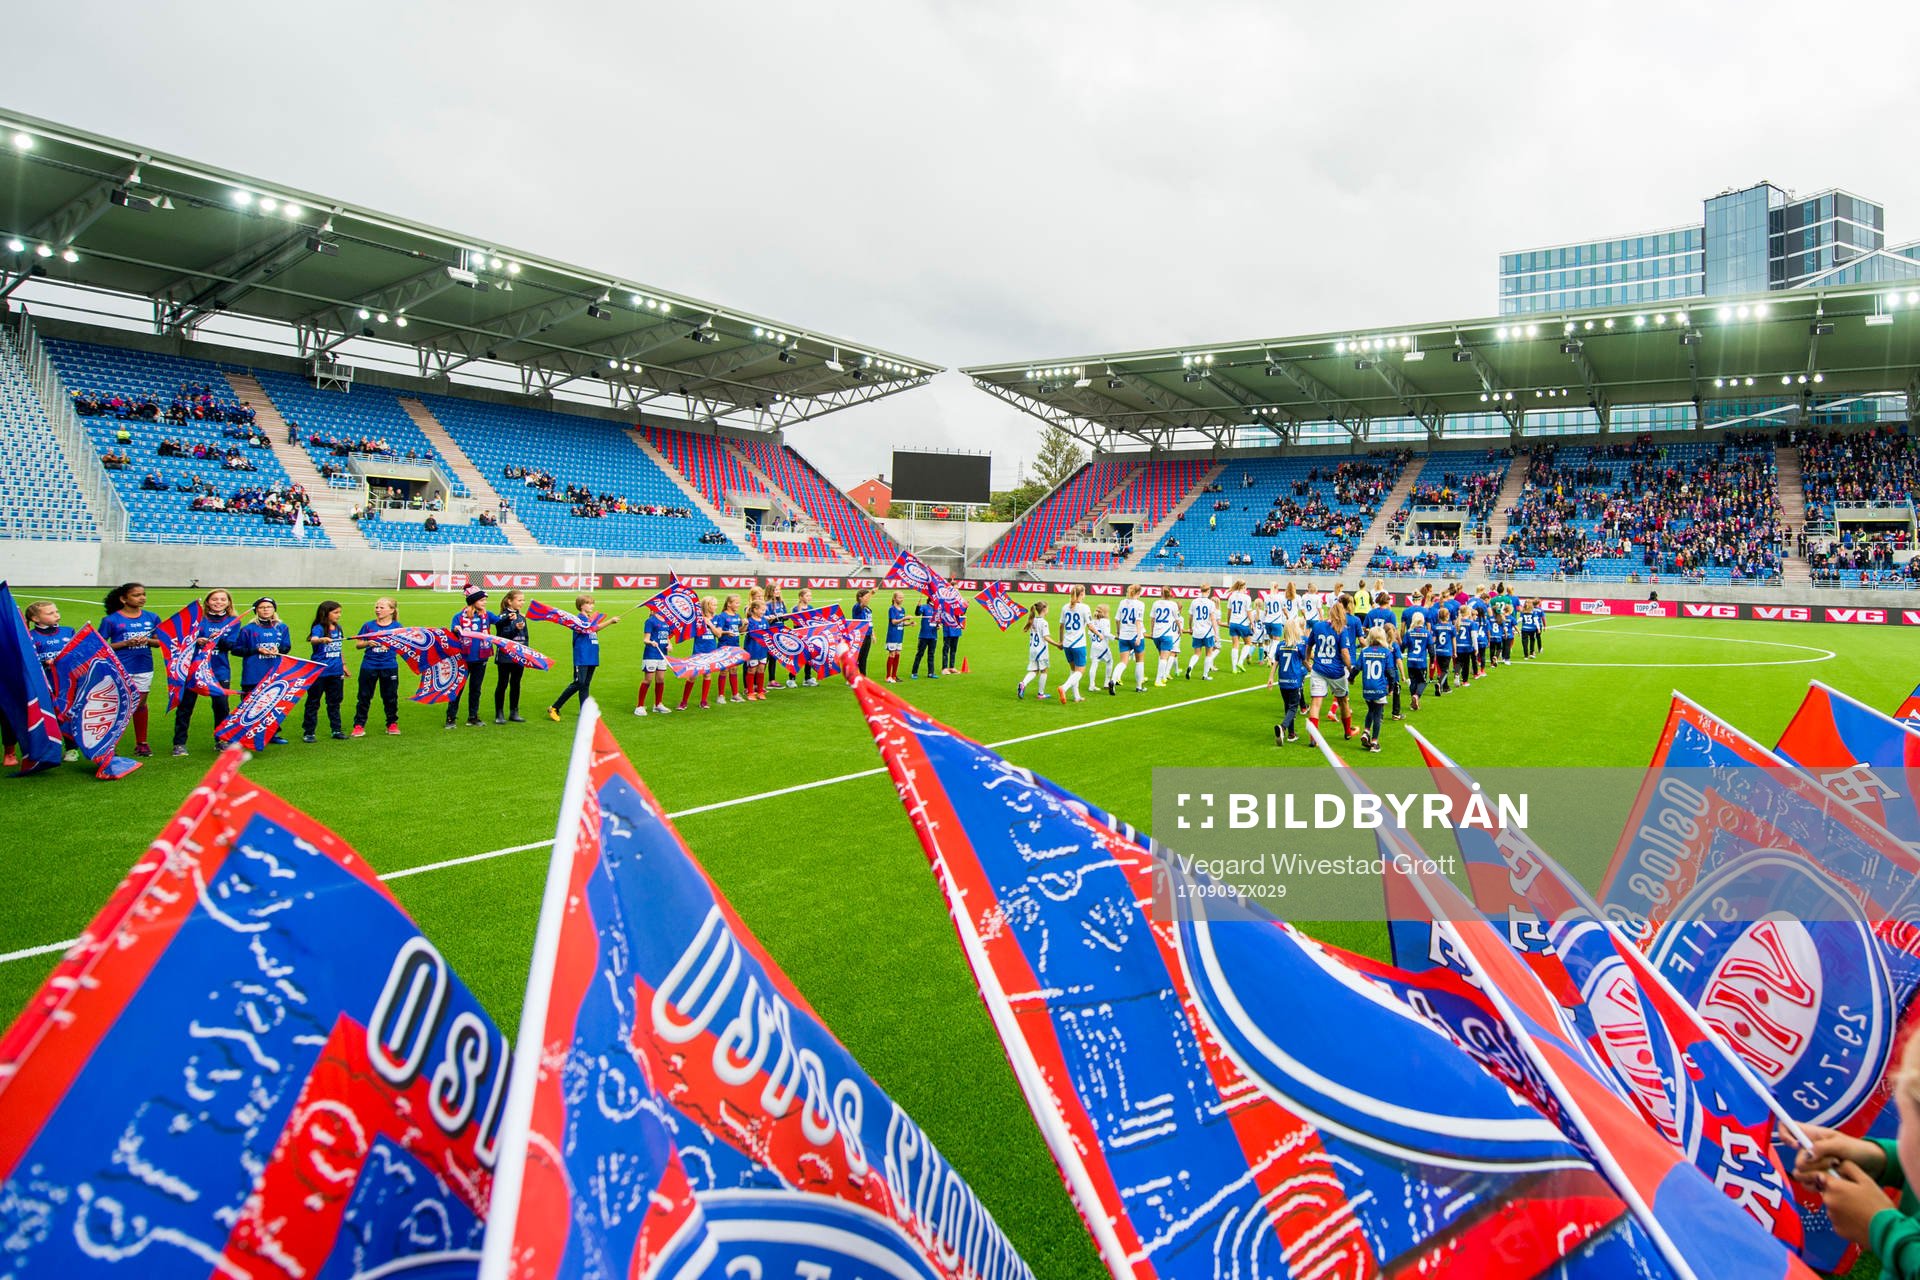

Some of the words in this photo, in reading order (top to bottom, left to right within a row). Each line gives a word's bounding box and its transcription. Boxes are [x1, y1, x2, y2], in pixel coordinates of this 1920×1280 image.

[485, 575, 537, 587] VG
[553, 576, 600, 587] VG
[615, 577, 657, 587] VG
[721, 577, 756, 588] VG
[809, 578, 838, 588] VG
[847, 579, 875, 588] VG
[1019, 583, 1046, 591] VG
[1092, 585, 1121, 594] VG
[1171, 588, 1201, 597] VG
[1231, 600, 1243, 614] 17
[1266, 601, 1280, 614] 10
[1286, 600, 1292, 612] 9
[1305, 600, 1312, 611] 6
[1360, 596, 1365, 606] 1
[1121, 607, 1136, 625] 24
[1155, 607, 1170, 623] 22
[1195, 605, 1209, 620] 19
[1685, 605, 1737, 618] VG
[1753, 607, 1809, 621] VG
[1827, 609, 1885, 623] VG
[1904, 611, 1920, 624] V
[1064, 612, 1081, 630] 28
[1438, 631, 1447, 645] 6
[1459, 625, 1468, 640] 2
[1317, 634, 1337, 658] 28
[1412, 639, 1424, 655] 5
[1282, 652, 1293, 672] 7
[1365, 660, 1383, 680] 10
